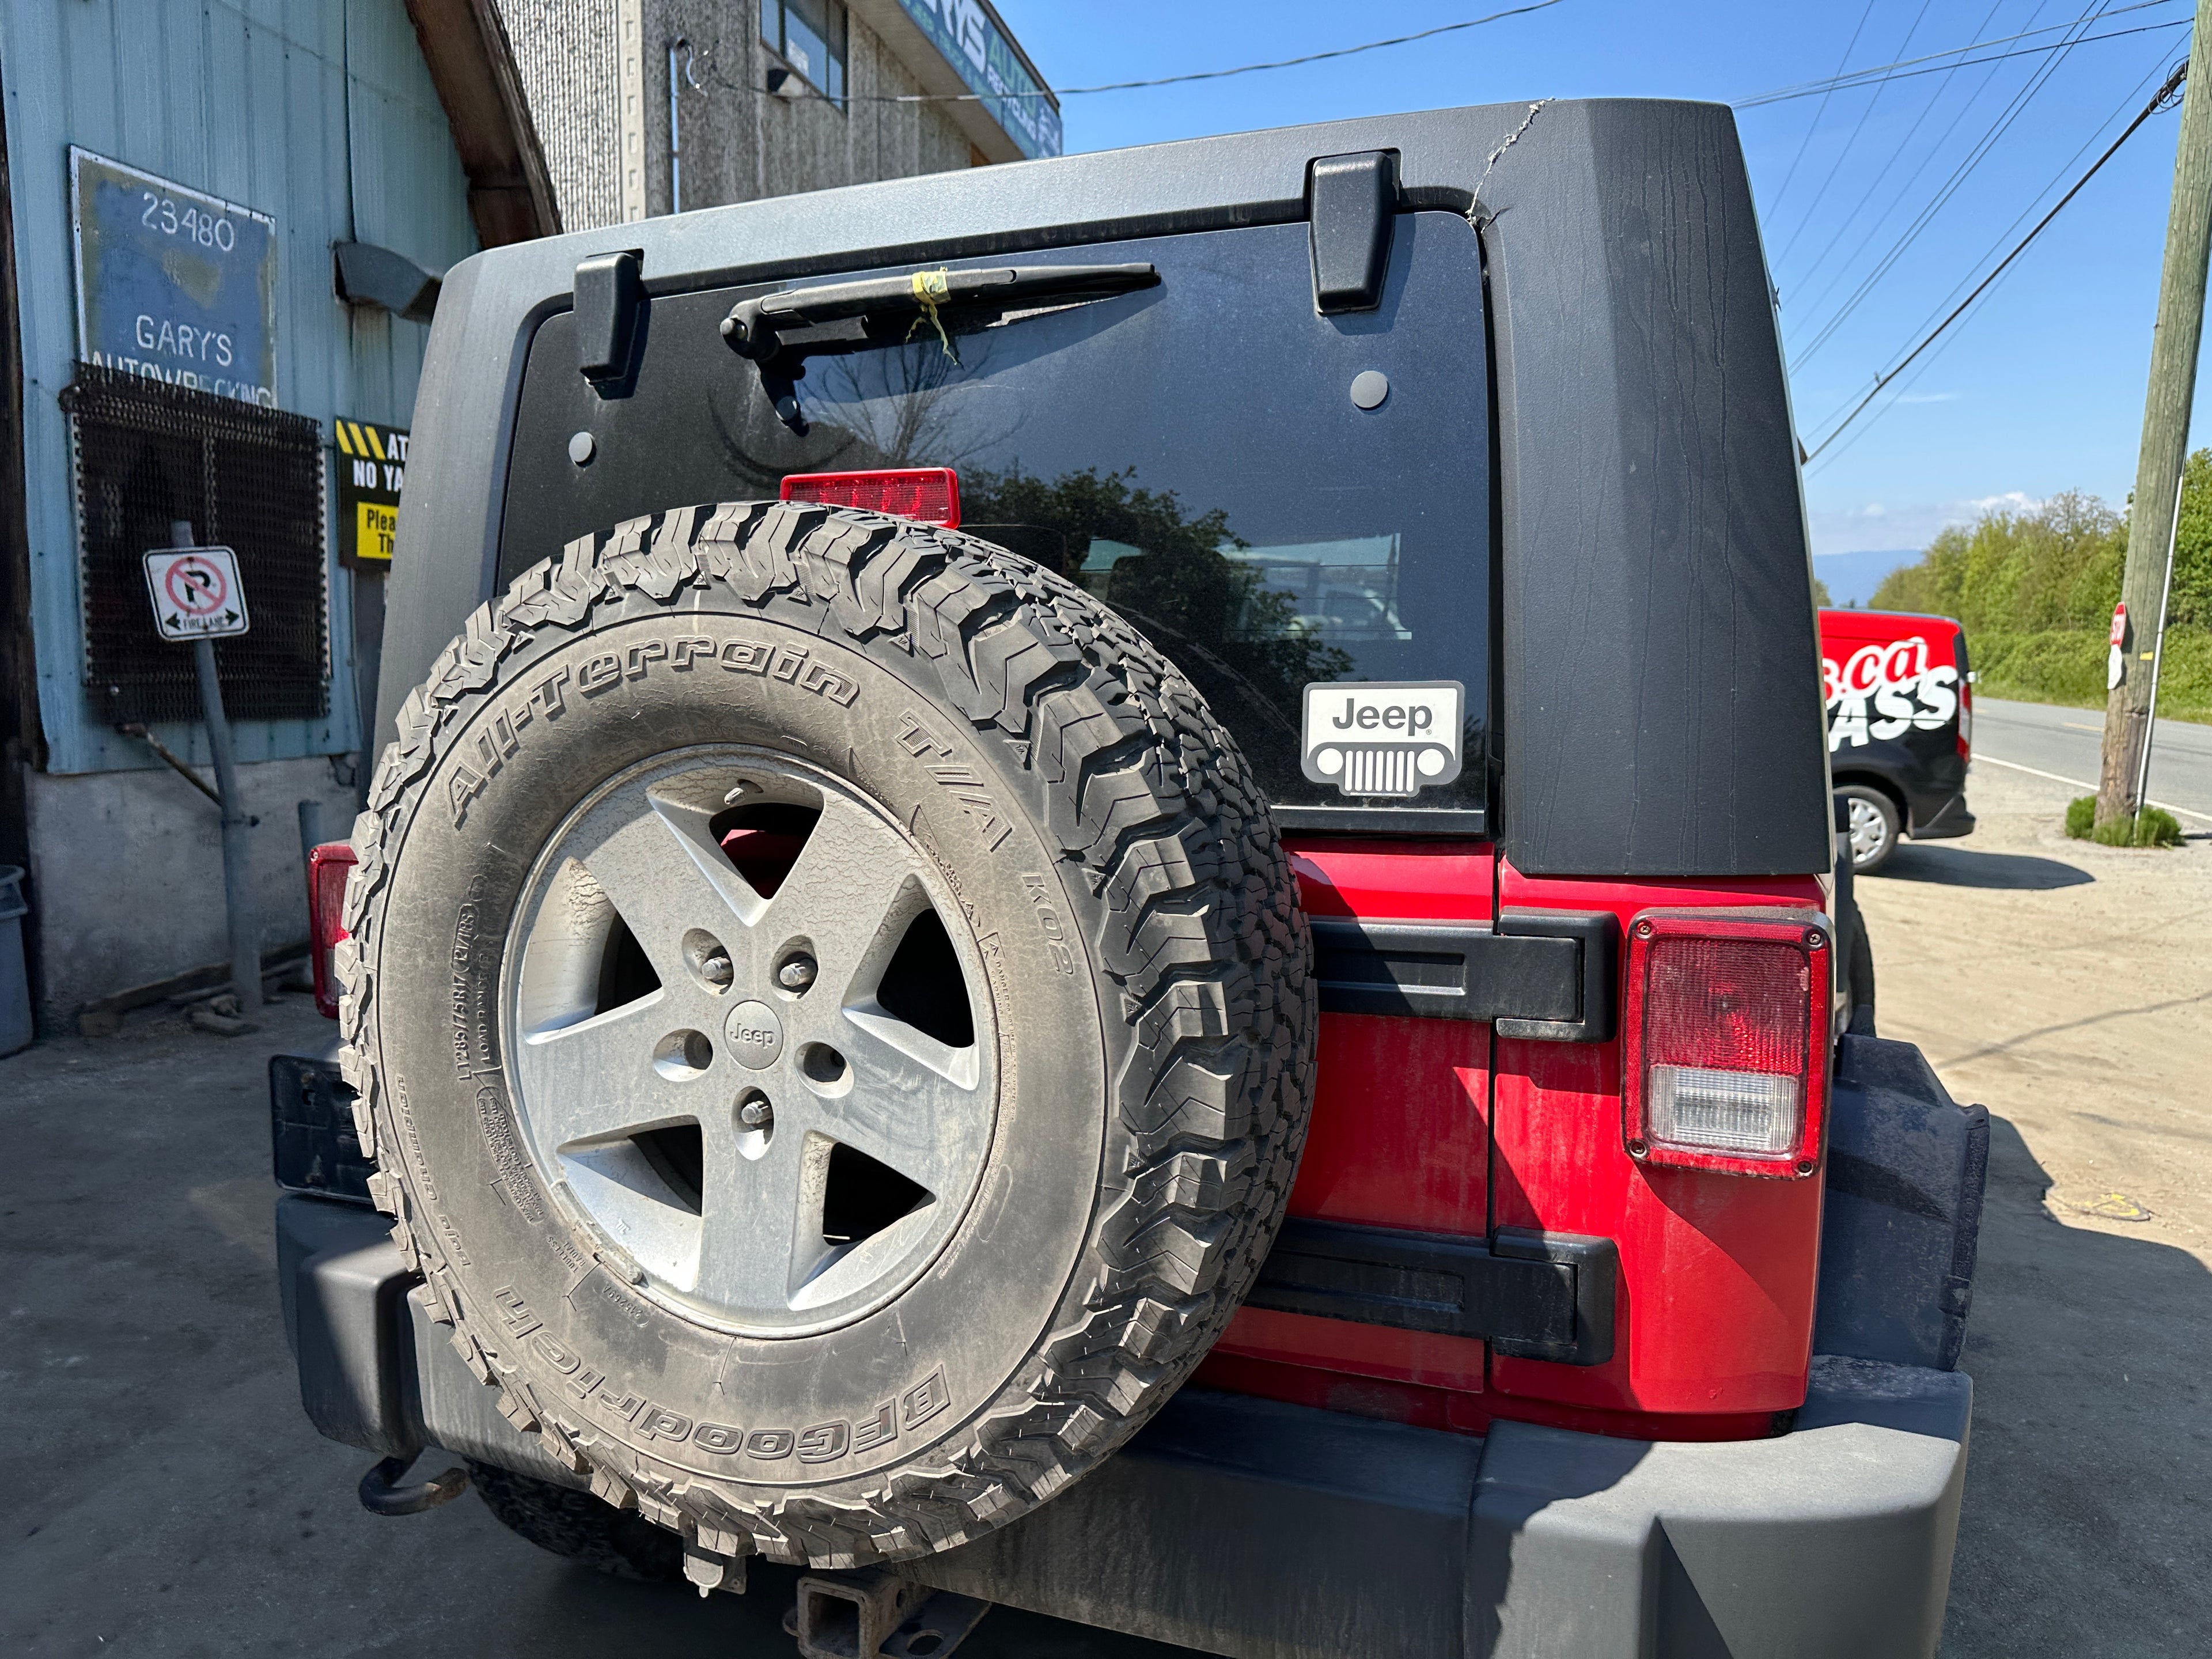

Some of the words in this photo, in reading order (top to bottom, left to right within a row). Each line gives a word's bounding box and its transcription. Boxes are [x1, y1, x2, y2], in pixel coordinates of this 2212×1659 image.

[142, 192, 235, 252] 23480
[136, 314, 233, 367] GARY'S
[353, 459, 377, 489] NO
[448, 634, 860, 830] All-Terrain
[1332, 698, 1433, 737] Jeep
[730, 1022, 776, 1049] Jeep
[547, 1236, 579, 1274] TUBELESS
[563, 1241, 586, 1267] RADIAL
[493, 1285, 951, 1464] BFGoodrich
